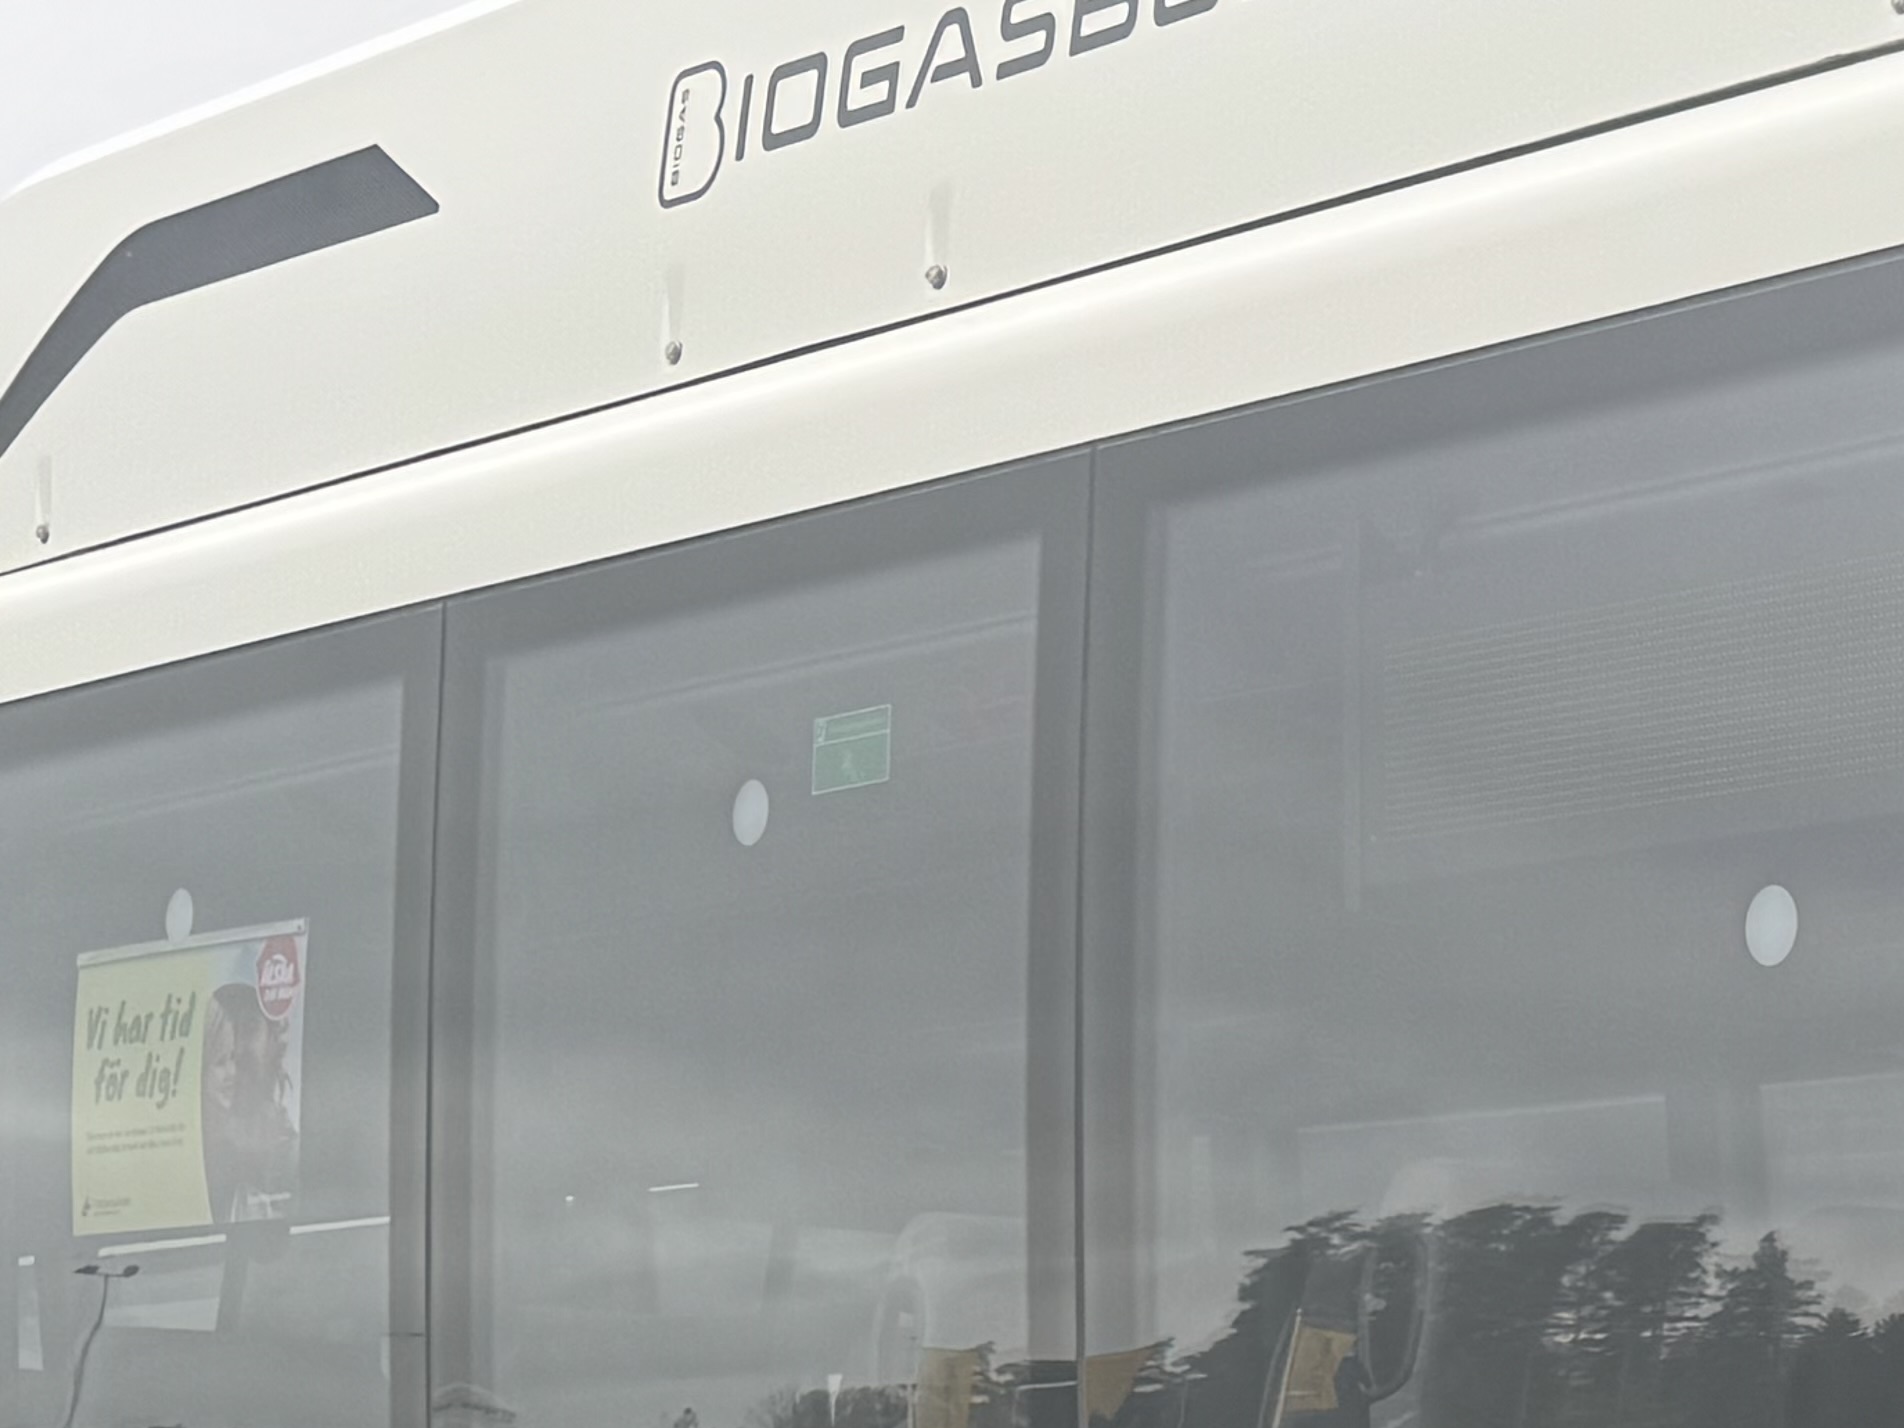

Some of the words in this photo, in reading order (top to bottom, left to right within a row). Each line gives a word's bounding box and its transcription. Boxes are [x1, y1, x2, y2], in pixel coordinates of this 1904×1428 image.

[670, 88, 690, 187] BIOGAS
[86, 1005, 110, 1051] Vi
[112, 1000, 155, 1047] har
[158, 991, 197, 1042] tid
[94, 1057, 130, 1105] för
[135, 1046, 185, 1110] dig!
